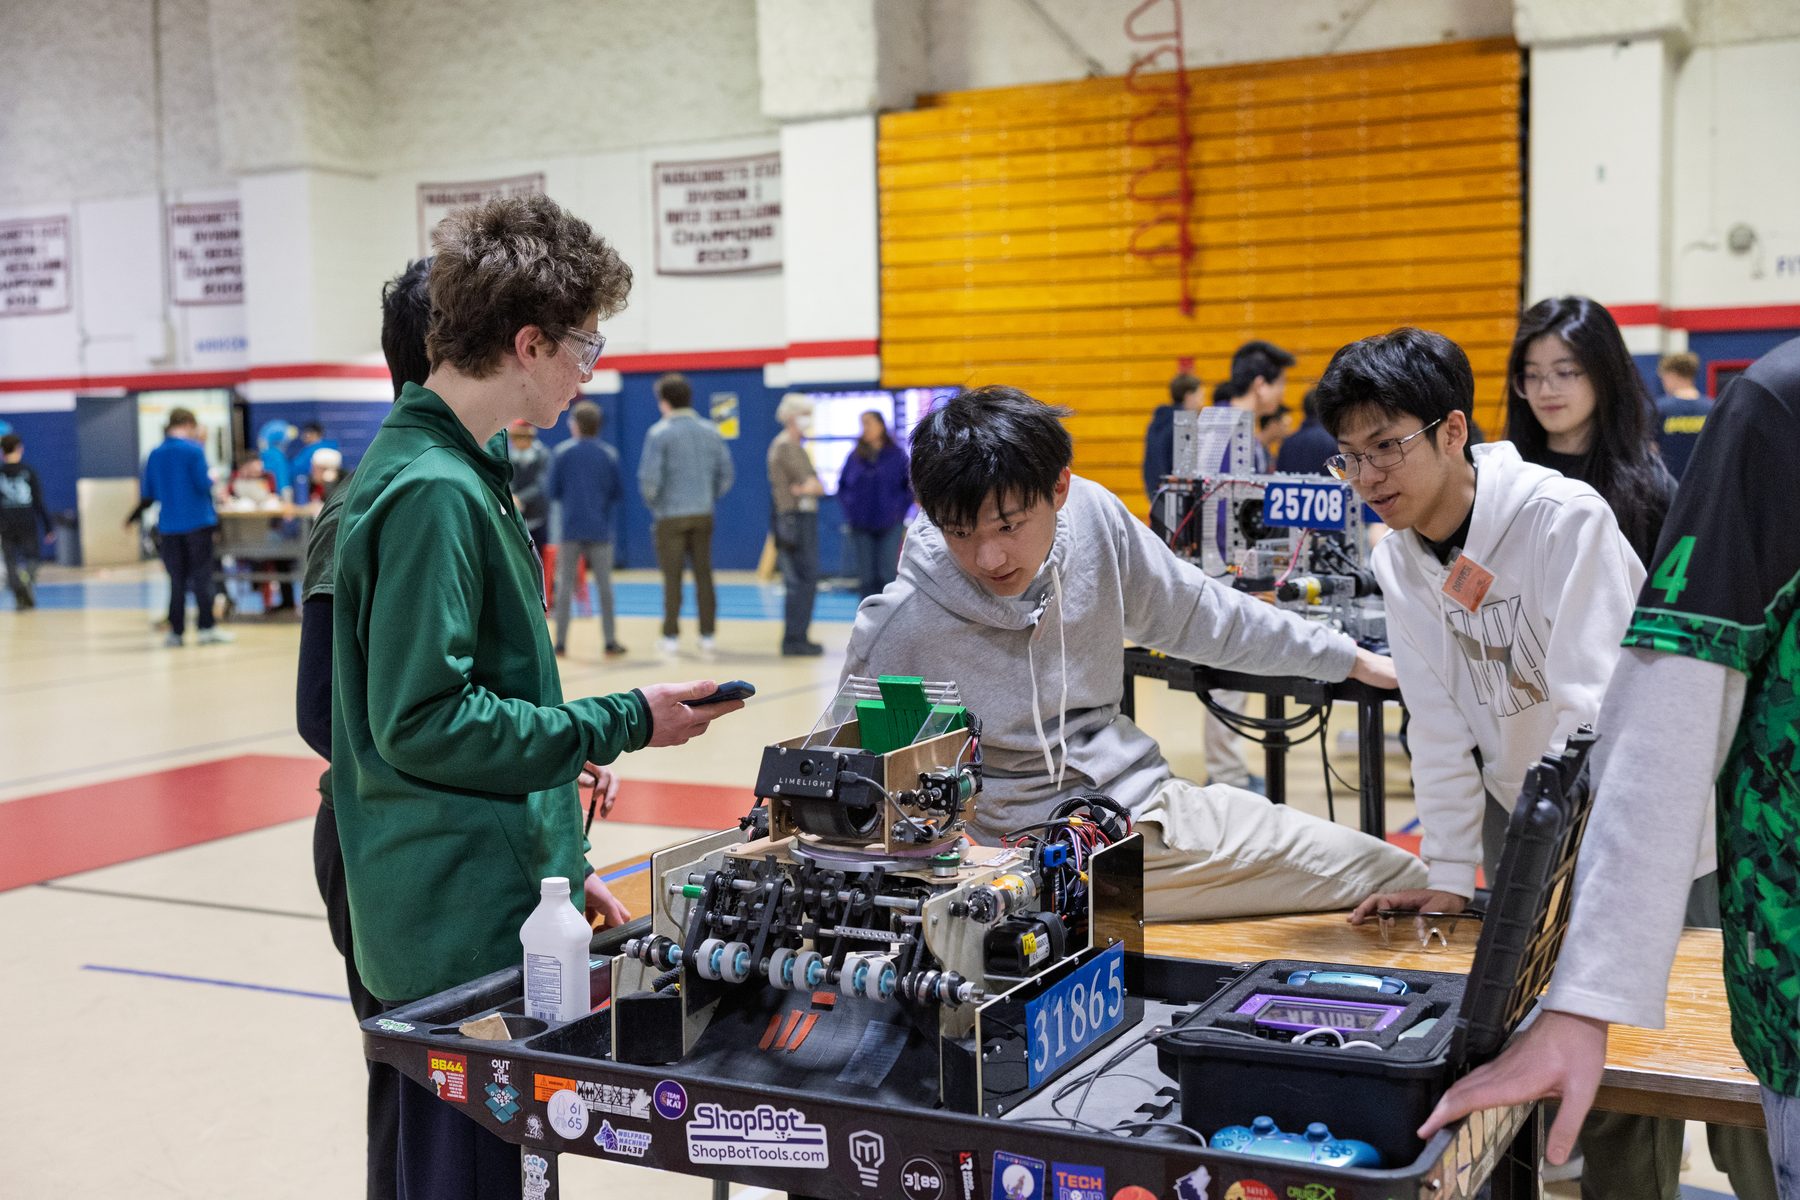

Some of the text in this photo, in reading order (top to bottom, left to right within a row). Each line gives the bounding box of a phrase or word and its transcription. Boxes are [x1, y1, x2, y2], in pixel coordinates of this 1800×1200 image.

[1269, 487, 1343, 522] 25708
[1652, 535, 1697, 604] 4
[779, 776, 831, 788] LIMELIGHT
[1033, 956, 1122, 1073] 31865
[491, 1059, 511, 1071] OUT
[493, 1073, 510, 1085] THE
[666, 1091, 681, 1100] TEAM
[569, 1102, 581, 1116] 61
[567, 1117, 583, 1130] 65
[689, 1106, 822, 1137] ShopBot
[618, 1130, 650, 1141] WOLFPACK
[619, 1144, 643, 1155] 18438
[691, 1144, 825, 1162] ShopBotTools.com
[1056, 1171, 1102, 1191] TECH
